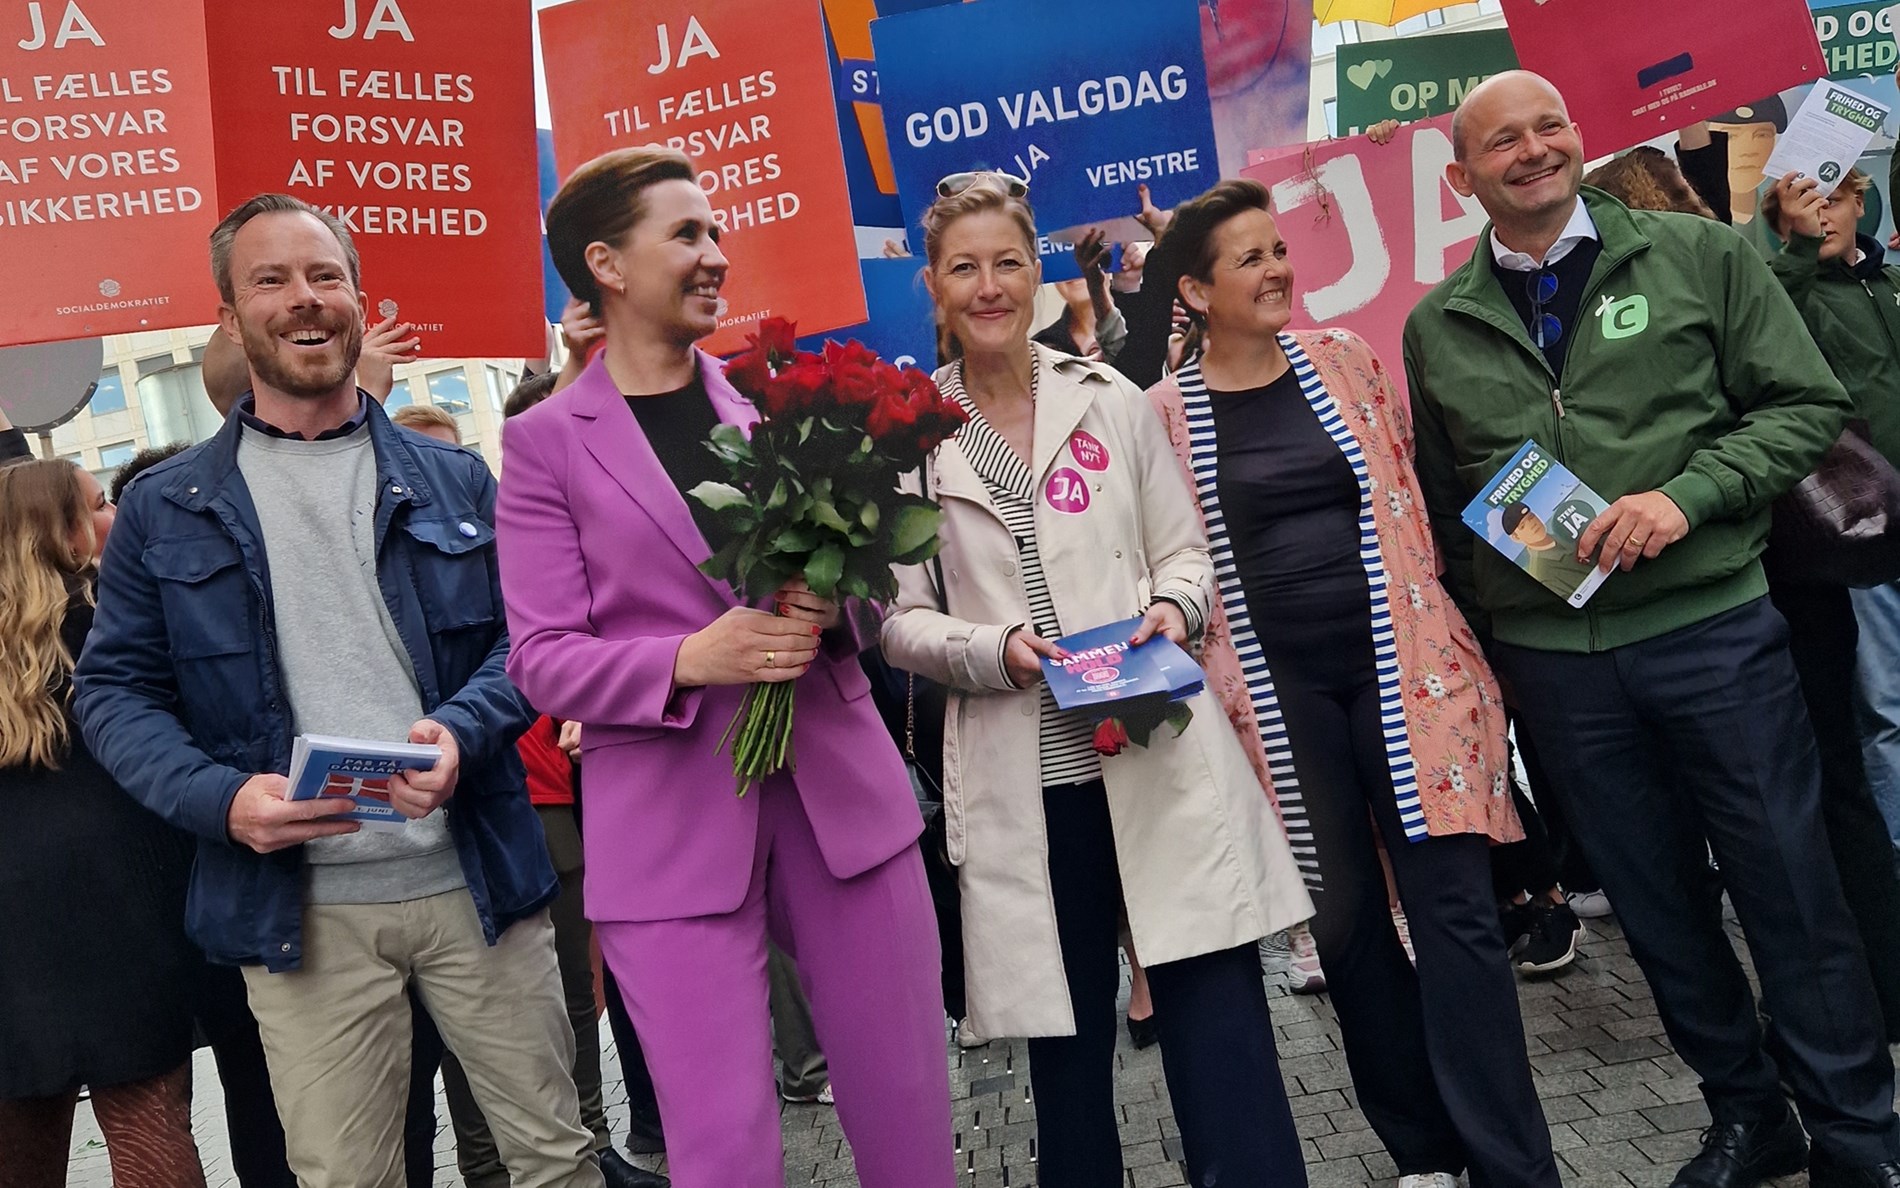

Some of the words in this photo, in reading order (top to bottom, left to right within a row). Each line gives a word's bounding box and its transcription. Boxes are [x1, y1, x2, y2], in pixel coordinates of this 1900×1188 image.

[18, 2, 106, 50] JA
[328, 0, 415, 42] JA
[647, 15, 720, 75] JA
[33, 68, 173, 100] FÆLLES
[271, 66, 327, 96] TIL
[339, 69, 475, 103] FÆLLES
[1390, 81, 1439, 111] OP
[603, 105, 650, 137] TIL
[658, 70, 777, 124] FÆLLES
[905, 100, 988, 148] GOD
[997, 65, 1188, 131] VALGDAG
[1829, 91, 1865, 112] FRIHED
[1865, 105, 1882, 120] OG
[1830, 102, 1875, 128] TRYGHED
[290, 113, 464, 147] FORSVAR
[49, 147, 180, 181] VORES
[287, 158, 335, 187] AF
[346, 160, 472, 192] VORES
[1085, 148, 1200, 189] VENSTRE
[1821, 167, 1835, 180] JA
[0, 186, 202, 227] IKKERHED
[1271, 127, 1491, 323] JA
[56, 296, 170, 315] SOCIALDEMOKRATIET
[1074, 438, 1101, 454] TANK
[1080, 450, 1101, 464] NYT
[1052, 477, 1085, 505] JA
[1489, 467, 1524, 505] FRIHED
[1521, 451, 1540, 469] OG
[1503, 459, 1549, 504] TRYGHED
[1557, 504, 1576, 523] STEM
[1563, 512, 1589, 539] JA
[1049, 641, 1130, 667] SAMMEN
